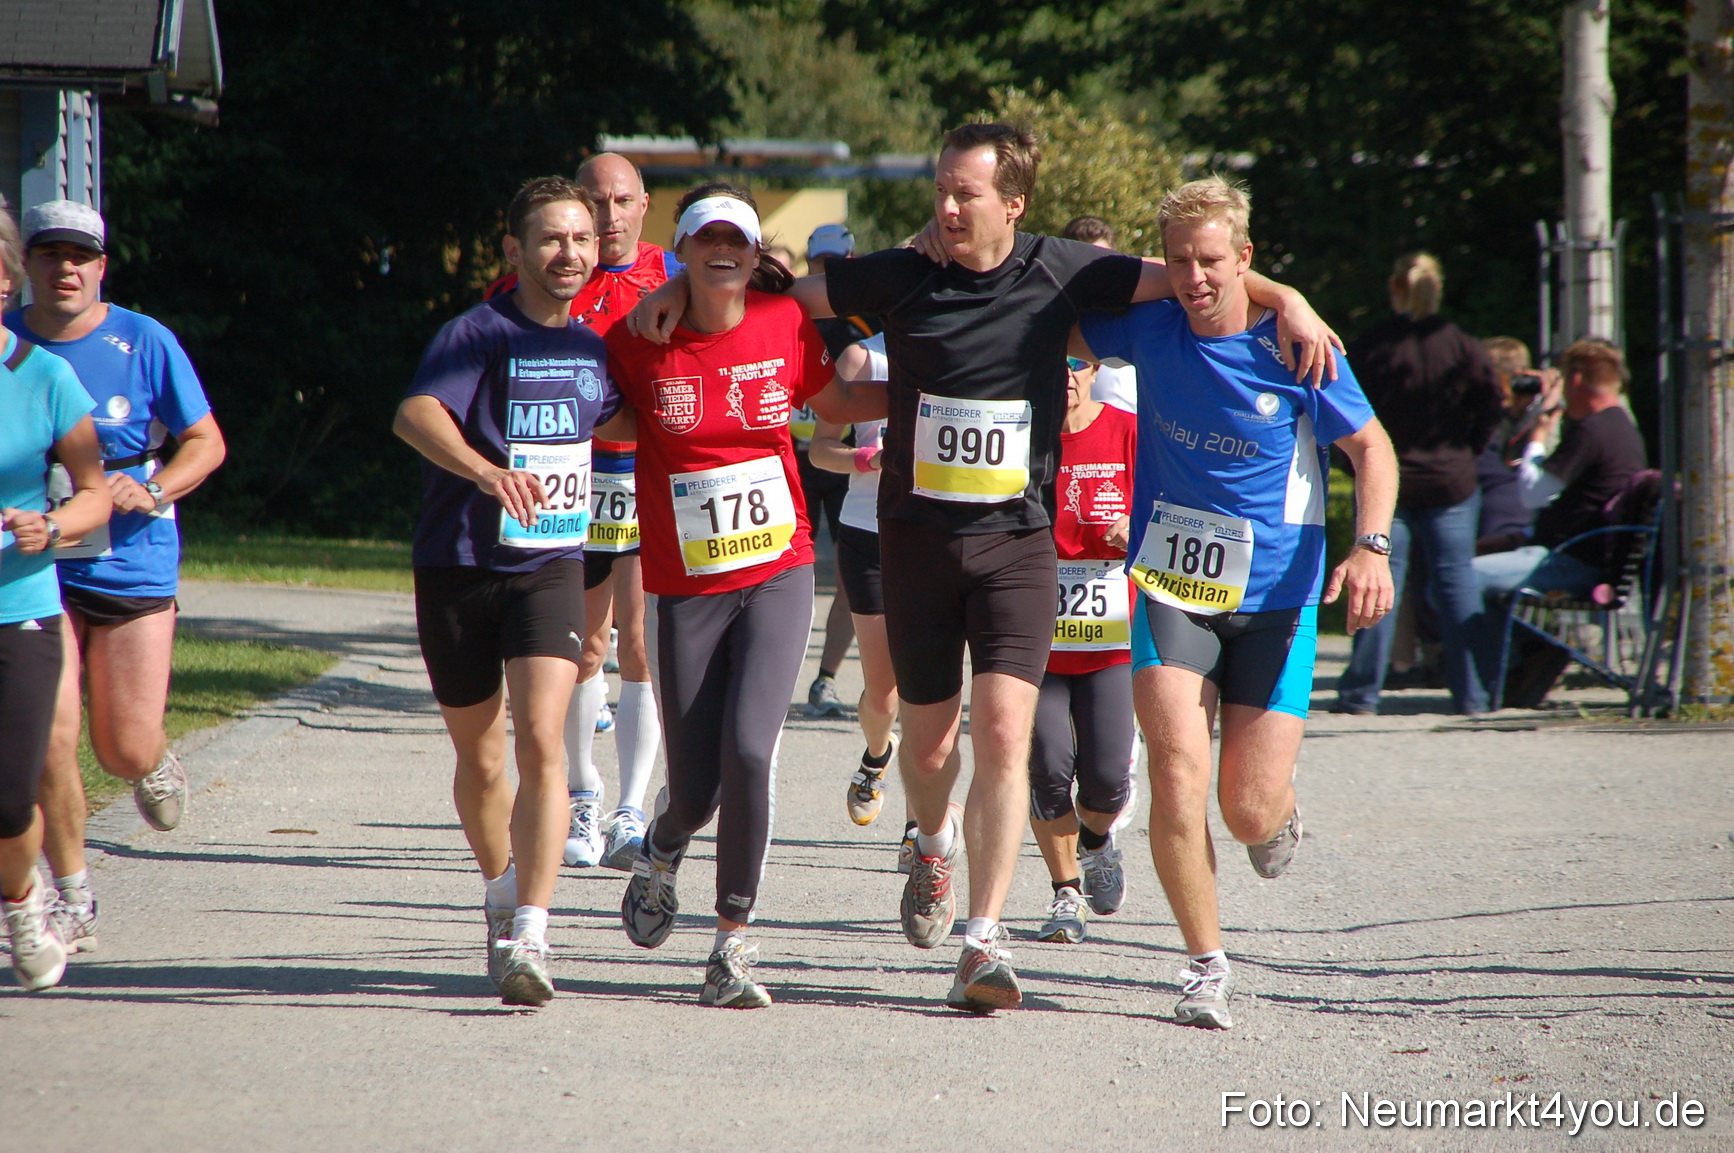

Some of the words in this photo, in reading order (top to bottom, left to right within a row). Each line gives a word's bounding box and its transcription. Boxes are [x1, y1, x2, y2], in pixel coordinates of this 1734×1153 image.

[718, 367, 731, 376] 11.
[731, 358, 786, 373] NEUMARKTER
[731, 368, 777, 382] STADTLAUF
[659, 393, 697, 404] WIEDER
[660, 384, 695, 395] IMMER
[661, 402, 695, 416] NEU
[932, 405, 981, 419] PFLEIDERER
[511, 403, 576, 436] MBA
[662, 415, 696, 424] MARKT
[937, 425, 1005, 466] 990
[1204, 431, 1259, 459] 2010
[1060, 466, 1072, 474] 11.
[1072, 463, 1126, 472] NEUMARKTER
[1071, 470, 1117, 479] STADTLAUF
[530, 471, 587, 510] 294
[688, 474, 737, 490] PFLEIDERER
[700, 488, 770, 534] 178
[1161, 511, 1205, 529] PFLEIDERER
[707, 532, 773, 559] Bianca
[1166, 533, 1225, 579] 180
[1144, 568, 1229, 604] Christian
[1055, 620, 1104, 642] Helga
